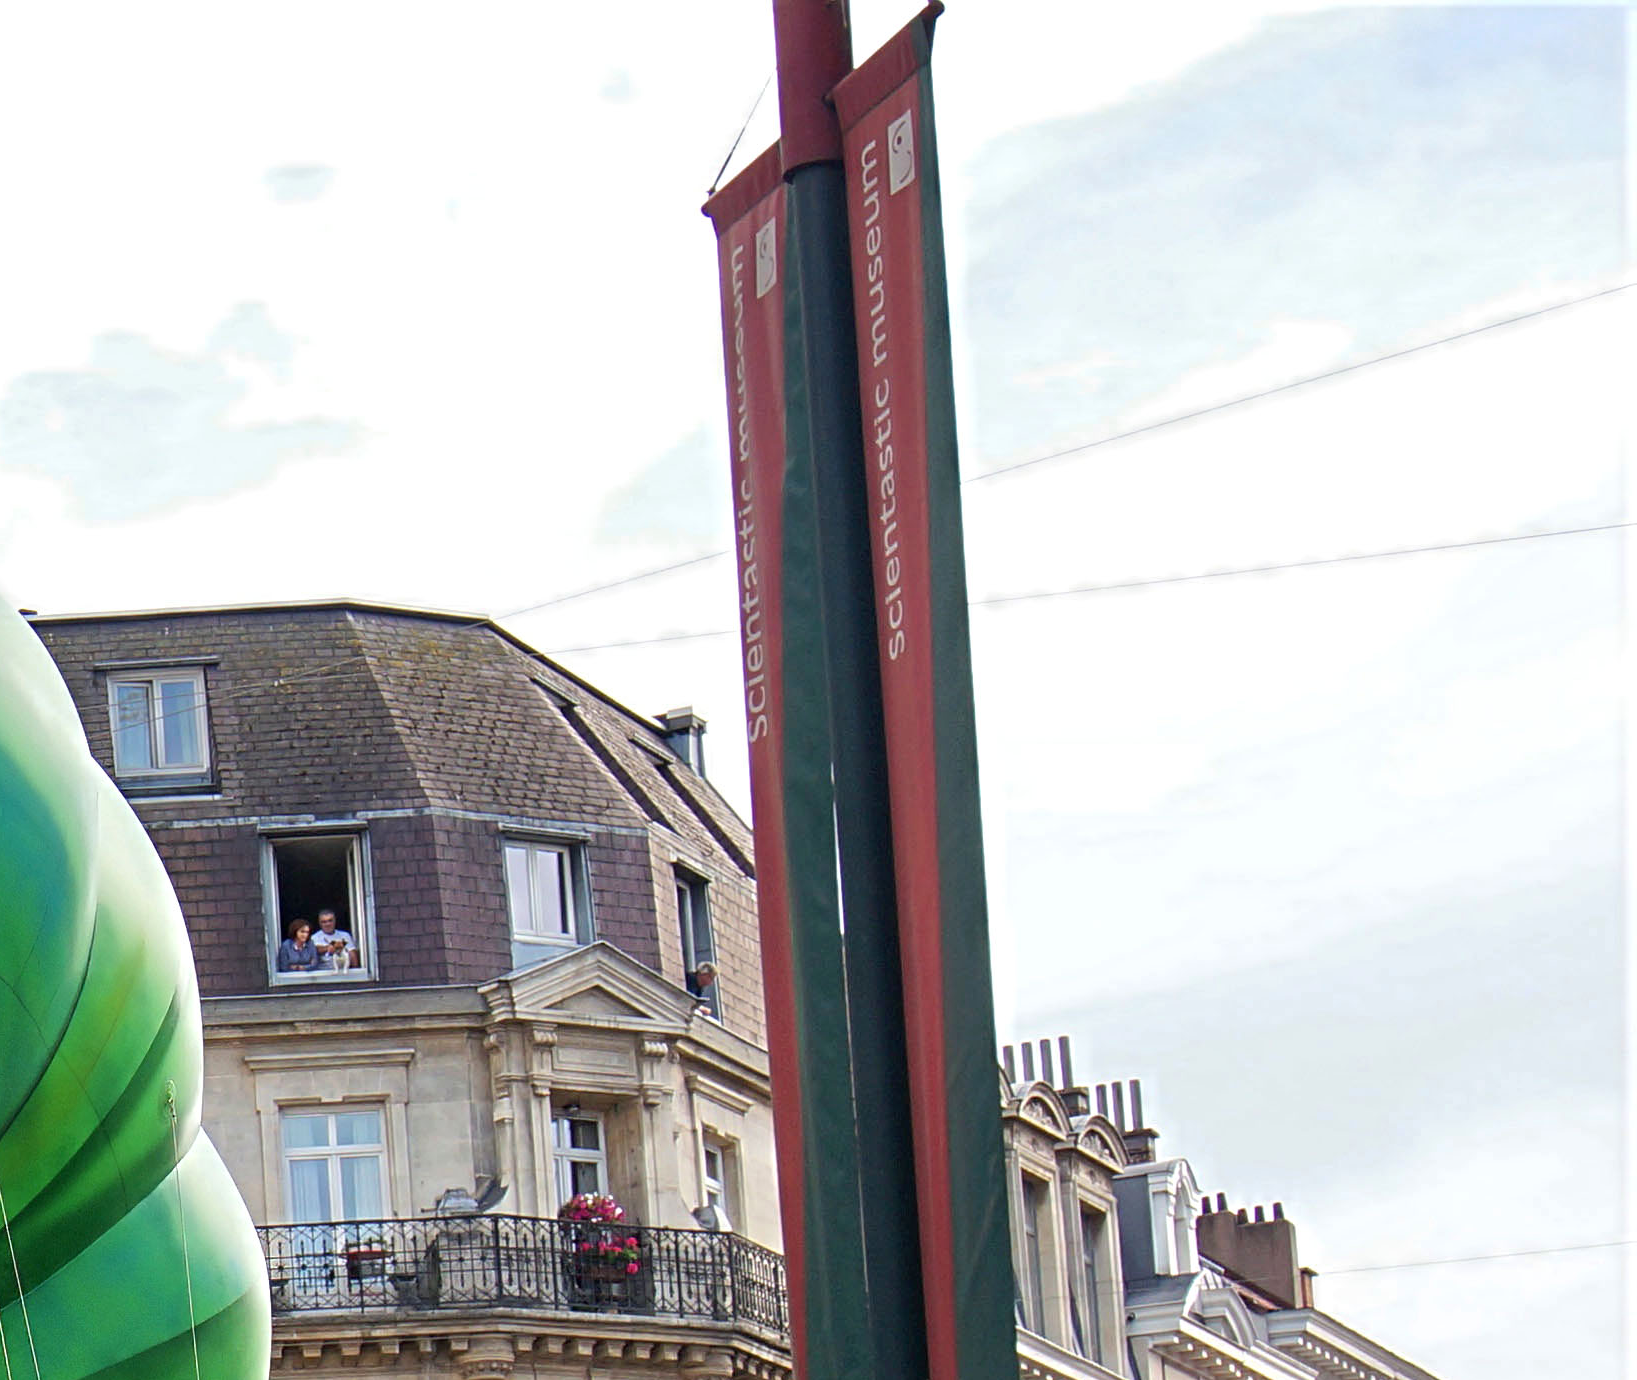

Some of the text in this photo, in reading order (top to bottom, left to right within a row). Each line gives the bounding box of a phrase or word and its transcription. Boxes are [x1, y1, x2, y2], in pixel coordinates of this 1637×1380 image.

[860, 138, 906, 661] scientastic museum
[737, 480, 768, 743] scientastic
